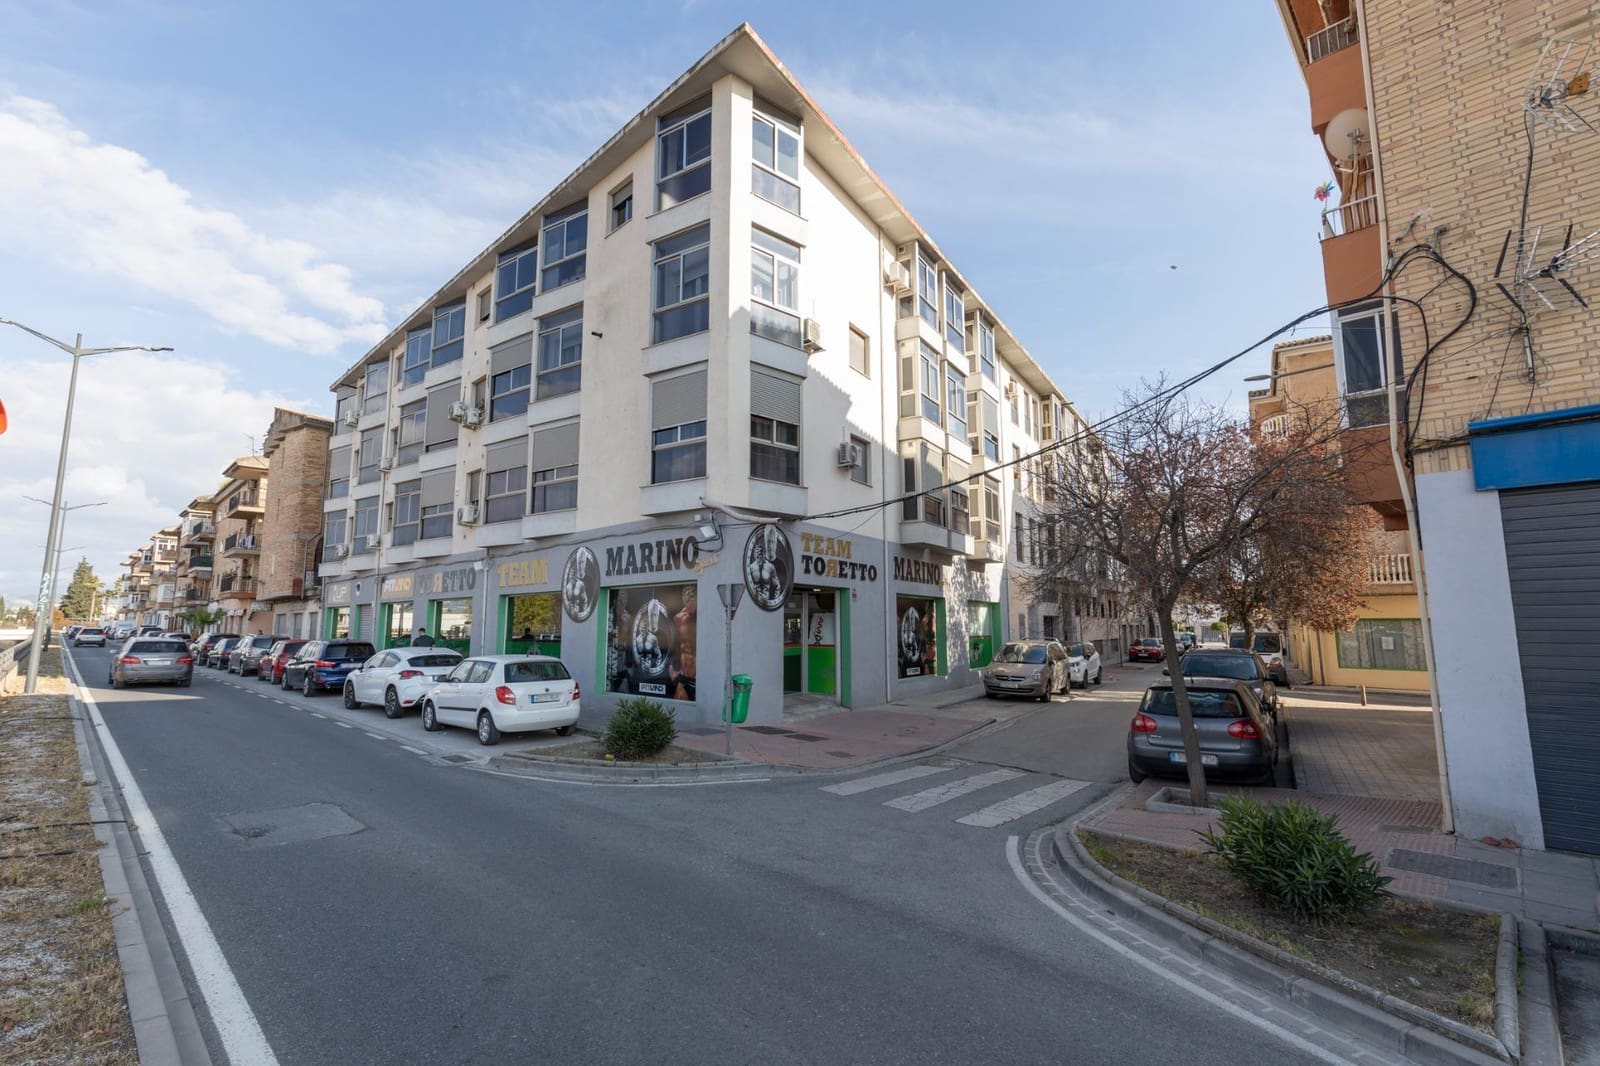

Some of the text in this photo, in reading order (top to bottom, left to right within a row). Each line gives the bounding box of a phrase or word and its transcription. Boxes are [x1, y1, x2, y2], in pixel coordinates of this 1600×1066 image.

[606, 535, 699, 577] MARINO
[801, 532, 852, 559] TEAM
[498, 559, 549, 587] TEAM
[893, 556, 941, 586] MARINO
